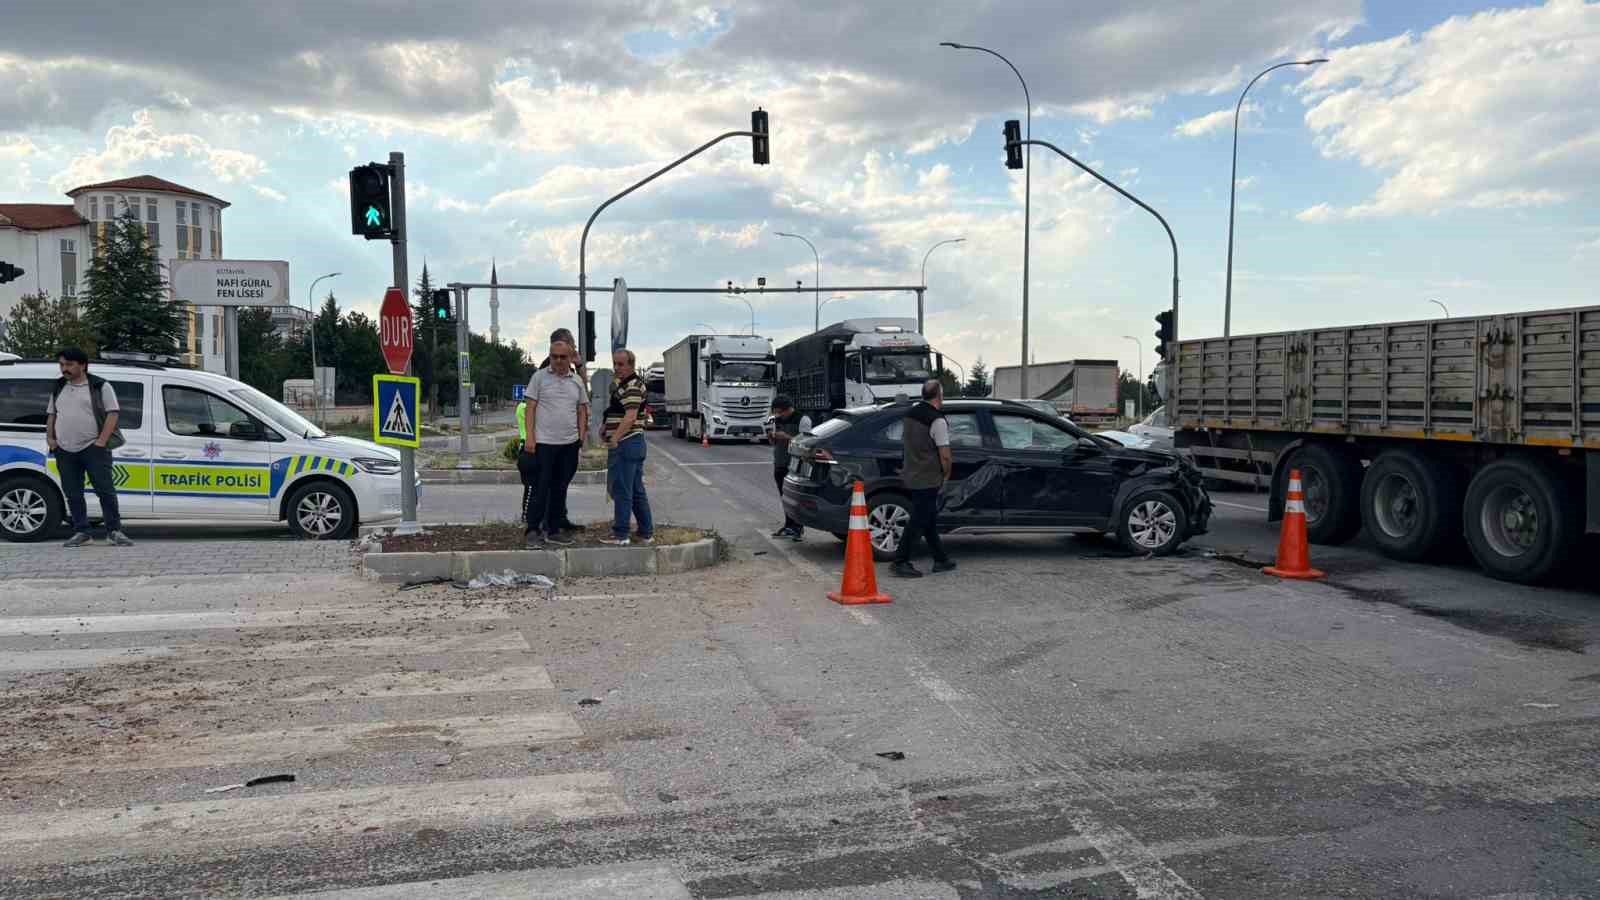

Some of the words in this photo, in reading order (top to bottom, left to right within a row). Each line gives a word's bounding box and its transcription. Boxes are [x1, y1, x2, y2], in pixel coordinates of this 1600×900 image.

[217, 277, 239, 287] NAFİ
[240, 277, 272, 288] GÜRAL
[217, 289, 235, 298] FEN
[237, 288, 264, 298] LİSESİ
[383, 315, 409, 348] DUR
[160, 472, 211, 486] TRAFİK
[216, 473, 261, 487] POLİSİ
